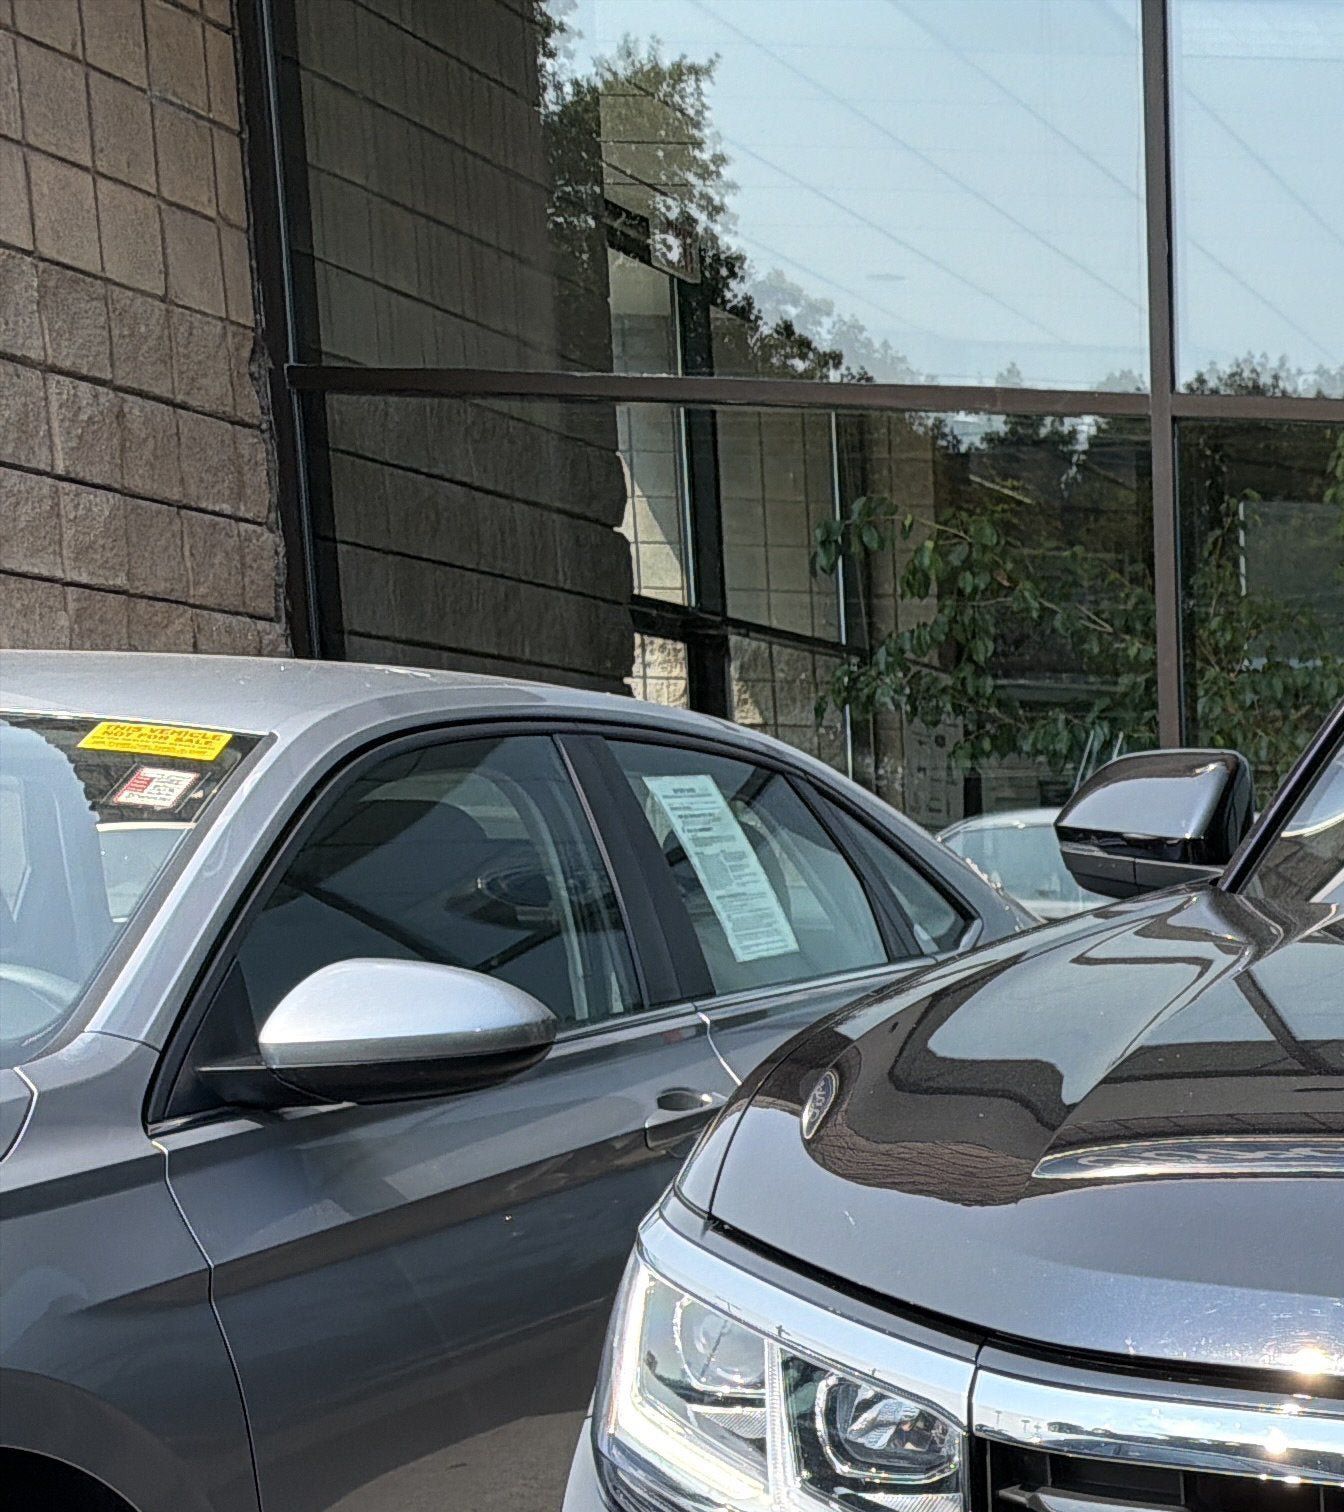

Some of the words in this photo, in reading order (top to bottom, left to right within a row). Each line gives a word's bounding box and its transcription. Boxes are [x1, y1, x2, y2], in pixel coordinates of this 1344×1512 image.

[102, 730, 132, 738] NOT
[137, 733, 170, 741] FOR
[105, 724, 143, 733] THIS
[149, 728, 225, 741] VEHICLE
